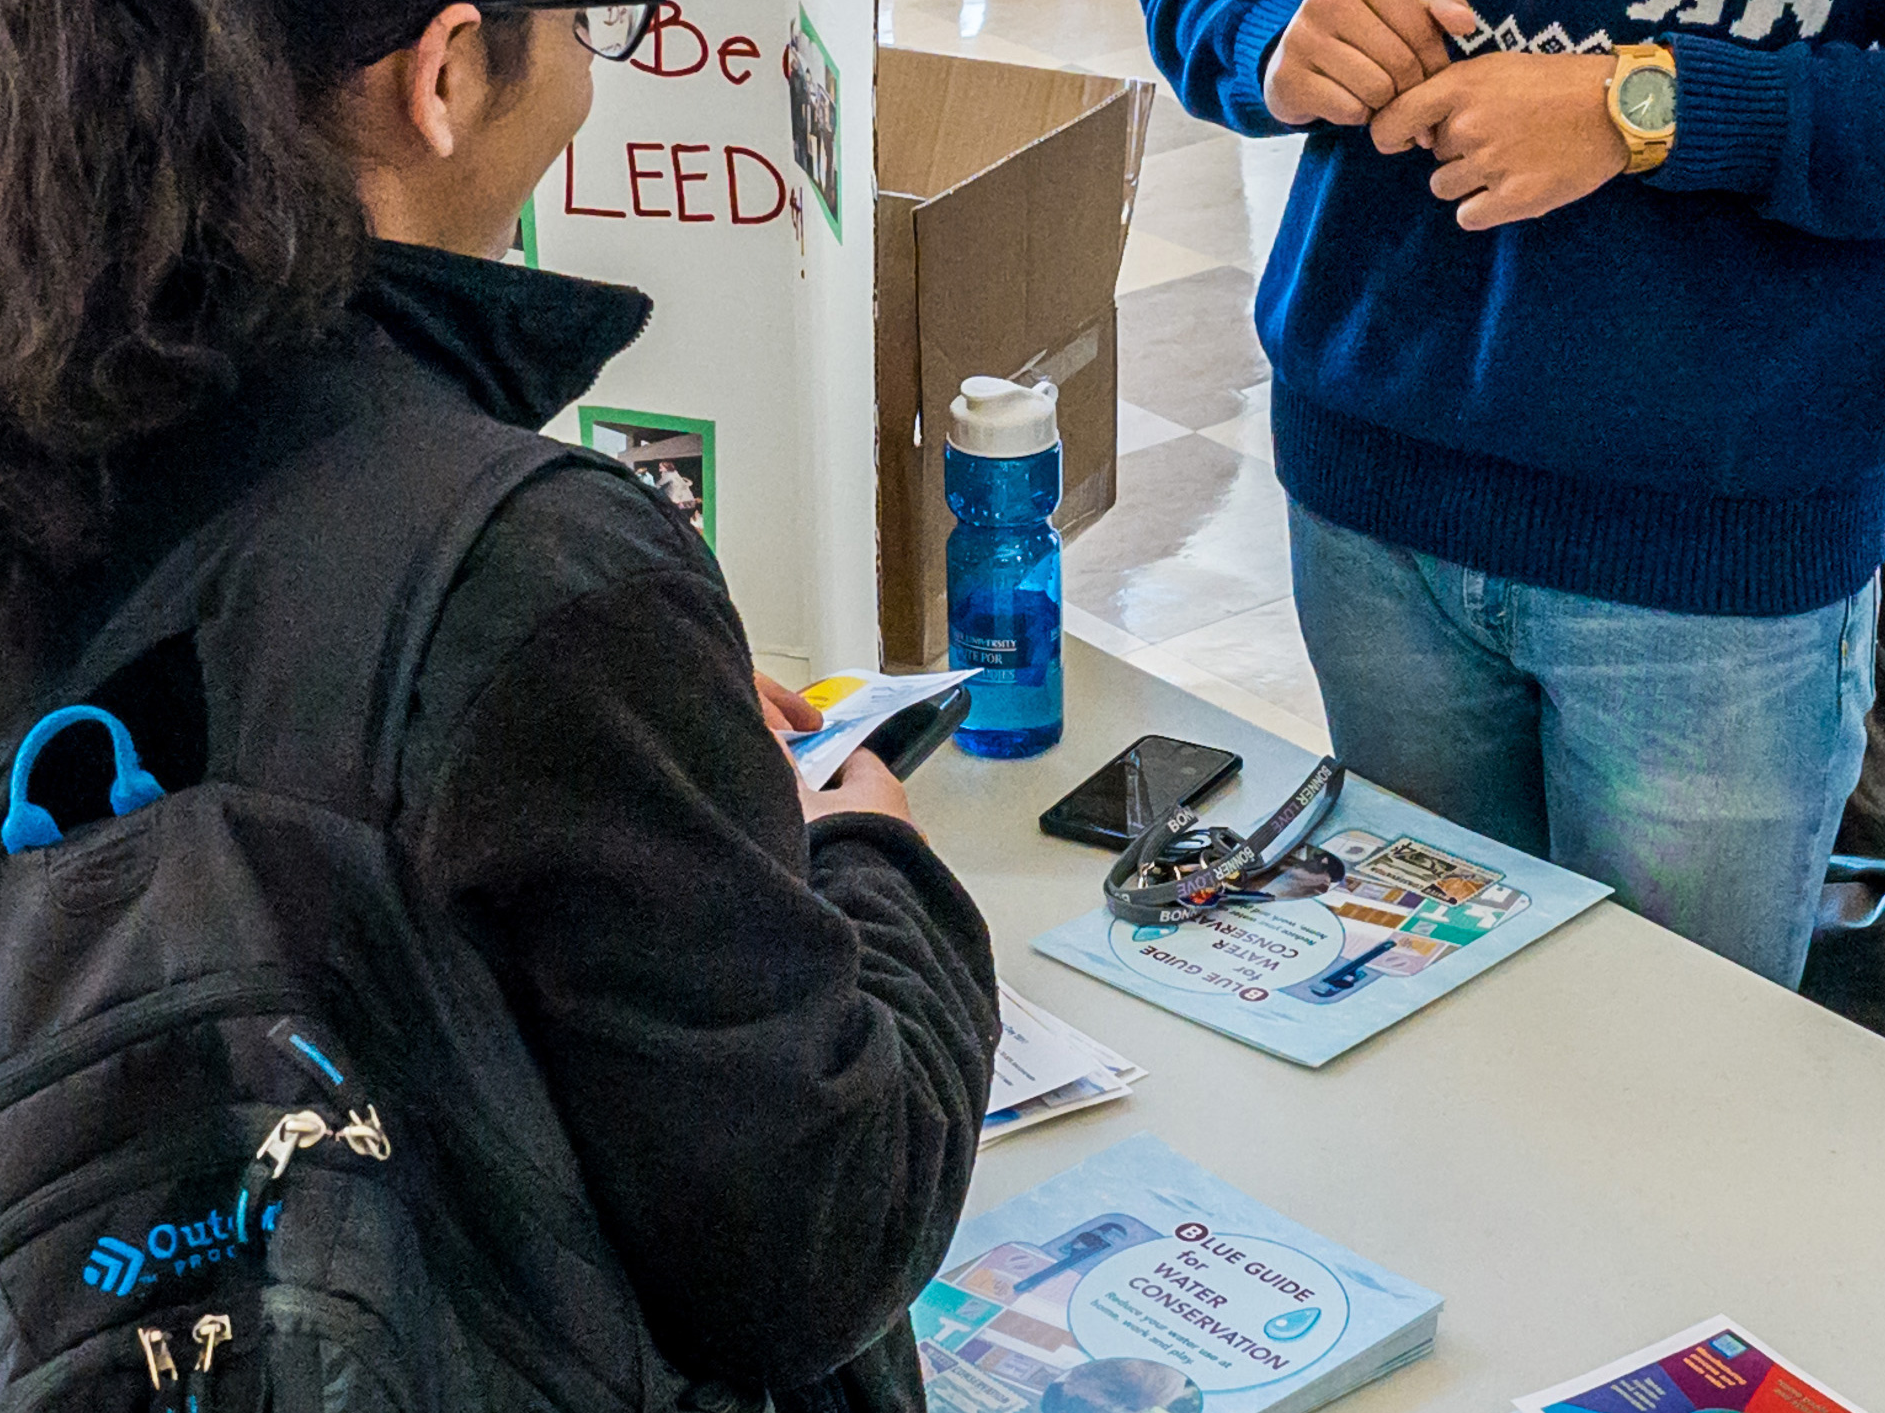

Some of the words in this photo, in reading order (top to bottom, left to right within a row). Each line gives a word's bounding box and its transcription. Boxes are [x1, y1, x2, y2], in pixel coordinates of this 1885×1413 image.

[629, 0, 761, 85] Be
[1296, 765, 1332, 807] BONNER
[1213, 845, 1256, 880] BONNER
[1138, 943, 1204, 976] GUIDE
[1210, 937, 1280, 971] WATER
[1229, 963, 1262, 983] for
[1200, 968, 1270, 1006] BLUE
[1171, 1216, 1251, 1267] BLUE
[1241, 1257, 1317, 1305] GUIDE
[1175, 1247, 1213, 1273] for
[1150, 1261, 1231, 1310] WATER
[1088, 1298, 1123, 1321] home,
[1120, 1318, 1151, 1339] work
[1148, 1335, 1172, 1352] and
[1167, 1345, 1197, 1366] play.
[1102, 1290, 1145, 1317] Reduce
[1140, 1313, 1169, 1334] your
[1164, 1328, 1200, 1351] water
[1197, 1346, 1219, 1362] use
[1216, 1357, 1233, 1370] at
[1126, 1274, 1290, 1370] CONSERVATION
